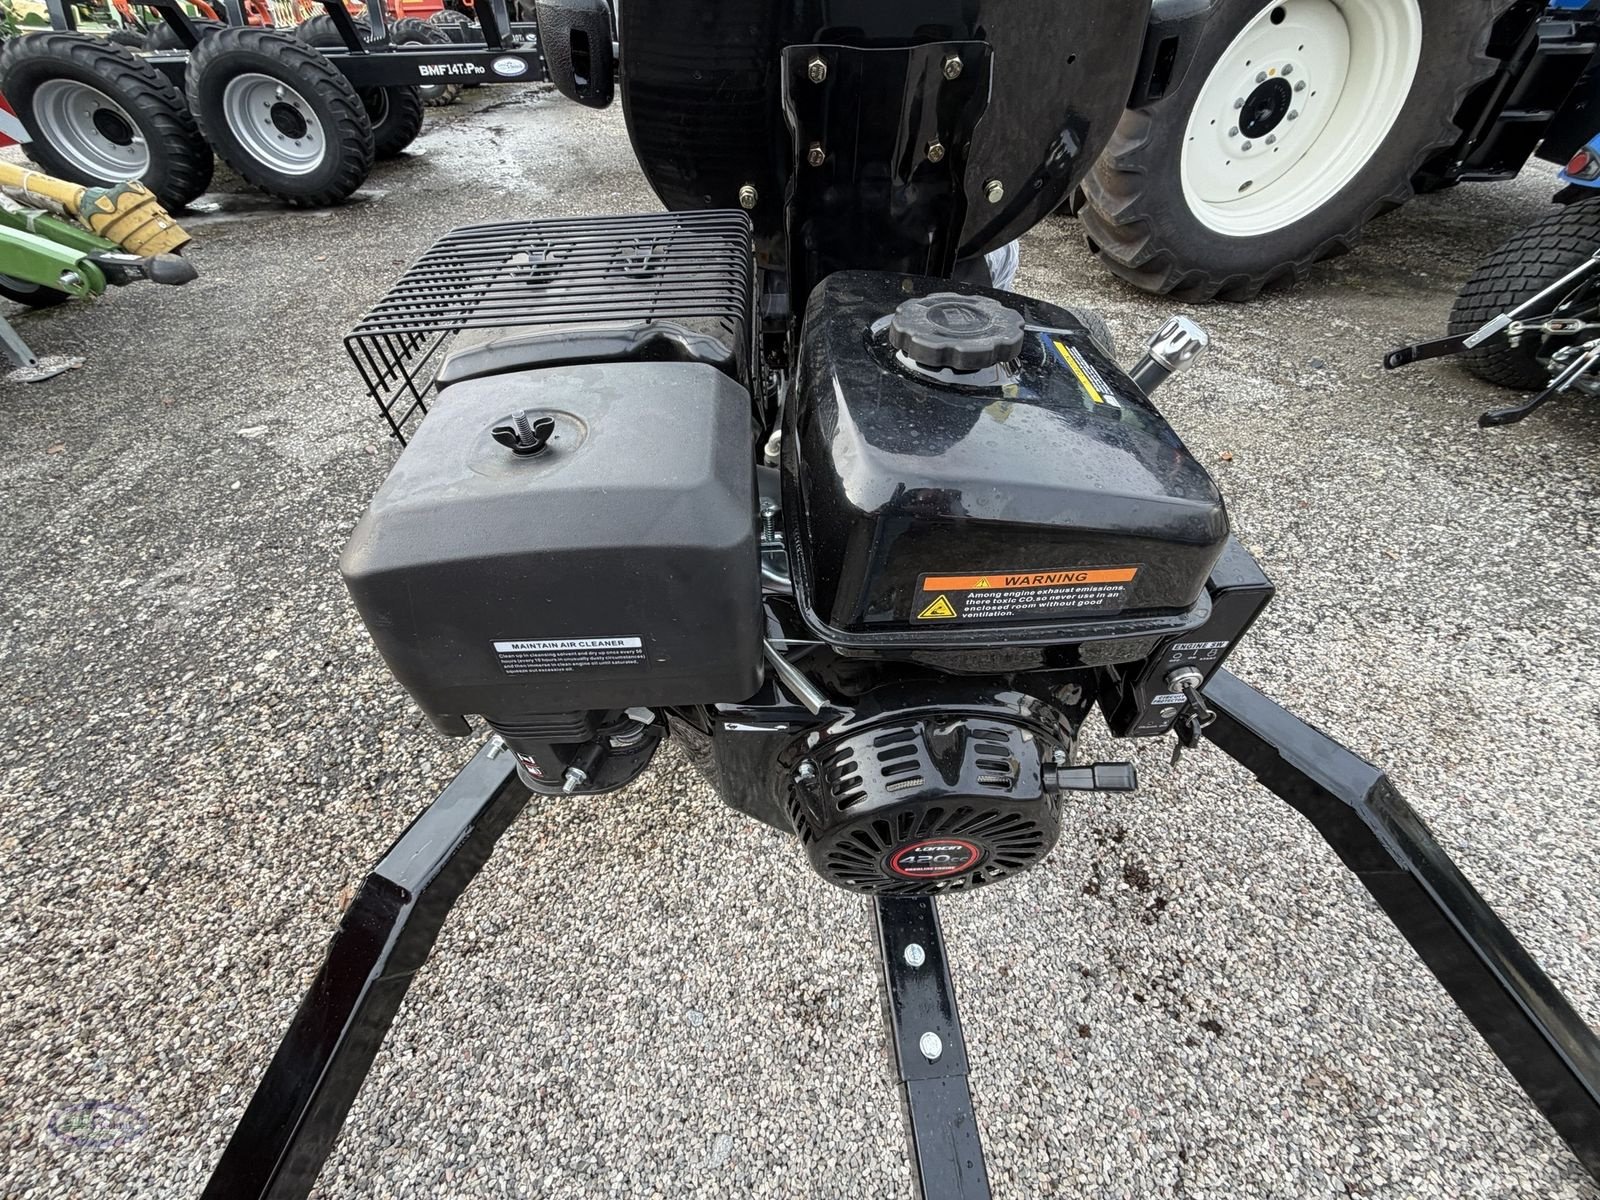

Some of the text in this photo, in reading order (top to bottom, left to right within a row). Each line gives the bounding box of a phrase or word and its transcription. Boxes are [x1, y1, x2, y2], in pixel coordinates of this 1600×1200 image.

[1005, 572, 1088, 586] WARNING
[967, 585, 1126, 599] Among engine exhaust emissions.
[1038, 600, 1076, 608] without
[1077, 598, 1103, 606] good
[962, 610, 1015, 618] ventilation.
[511, 642, 558, 650] MAINTAIN
[578, 640, 625, 648] CLEANER
